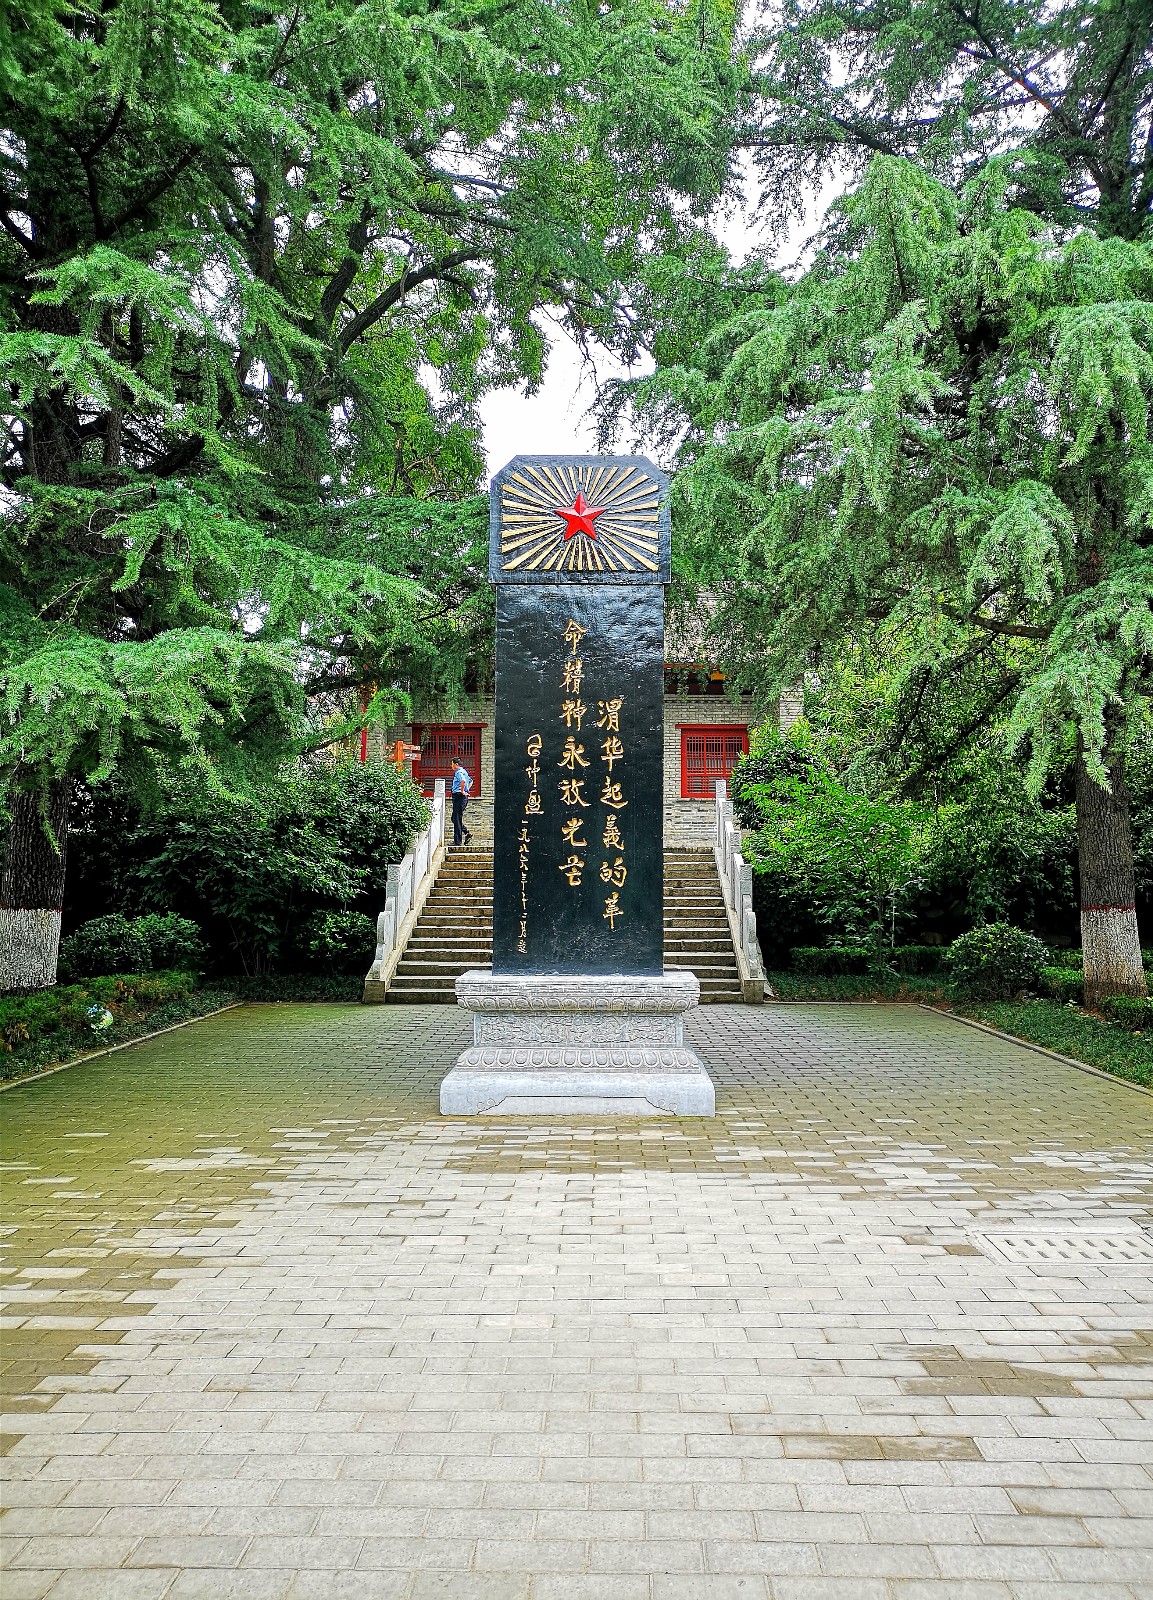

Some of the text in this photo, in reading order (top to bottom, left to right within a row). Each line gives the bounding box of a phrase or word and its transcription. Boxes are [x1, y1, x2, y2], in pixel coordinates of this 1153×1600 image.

[557, 618, 592, 887] 命精神永放光芒
